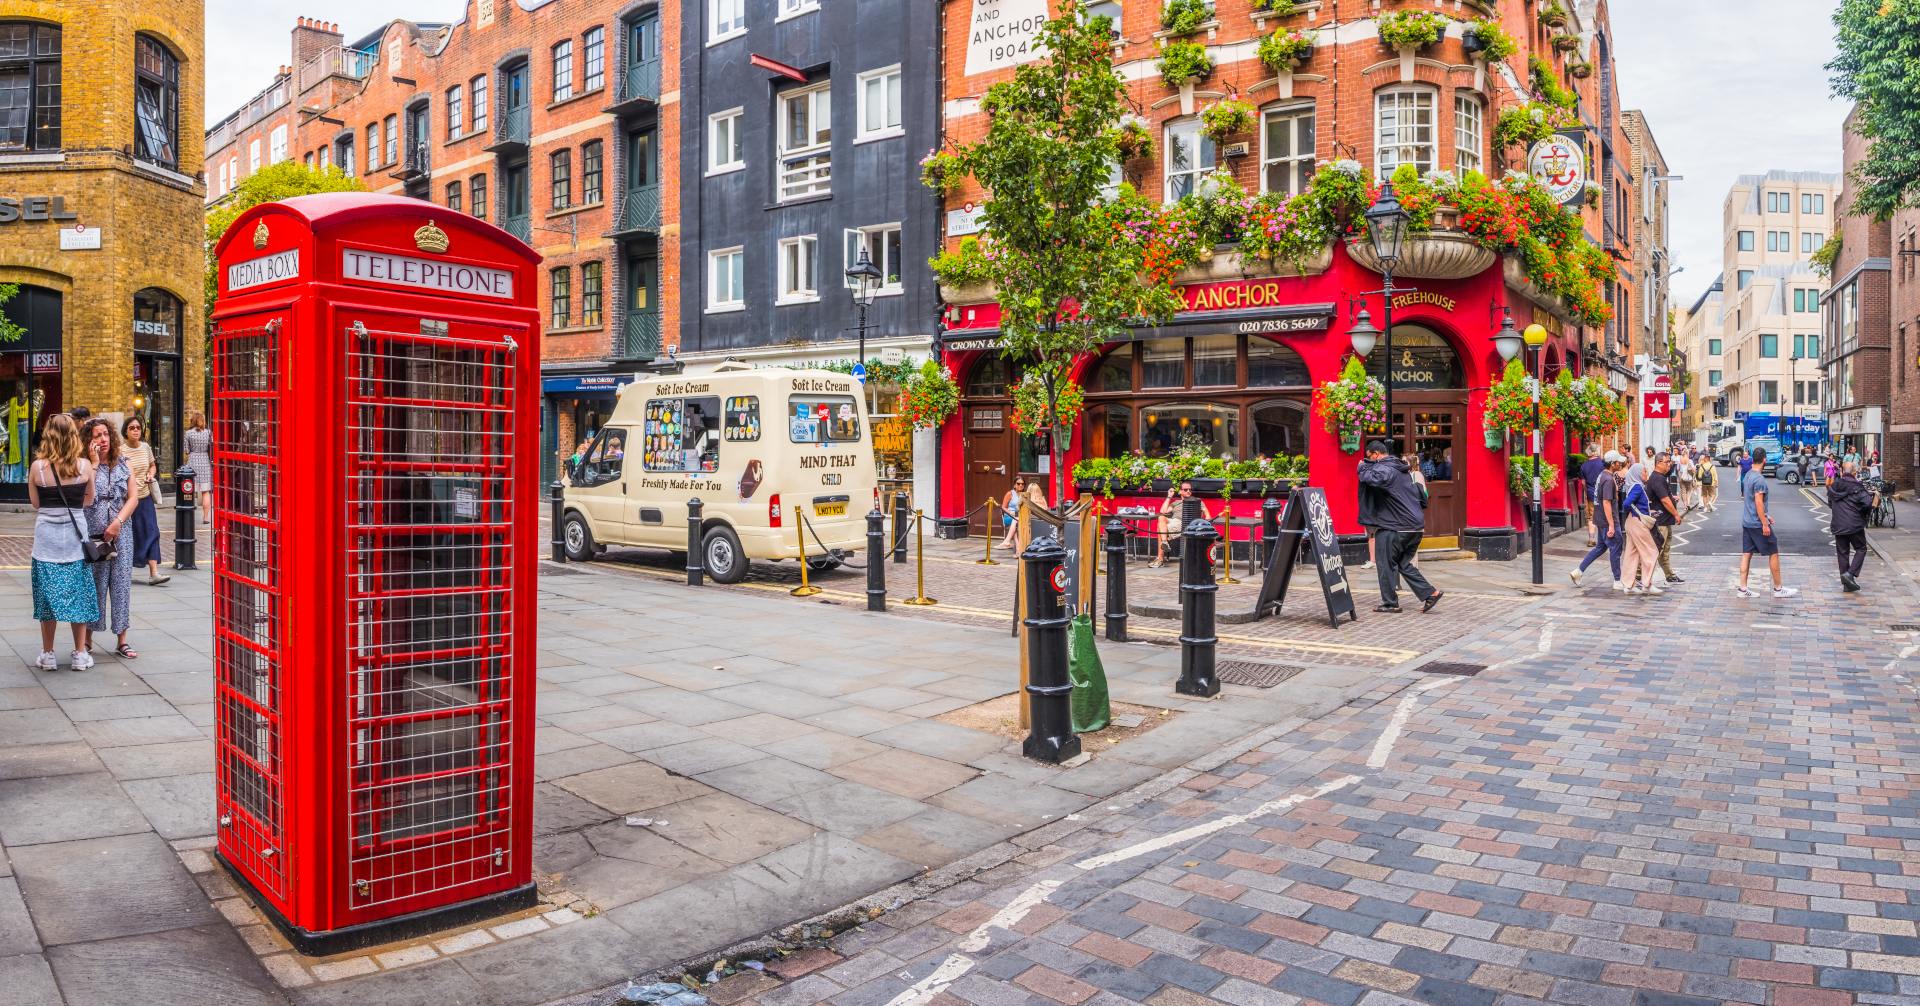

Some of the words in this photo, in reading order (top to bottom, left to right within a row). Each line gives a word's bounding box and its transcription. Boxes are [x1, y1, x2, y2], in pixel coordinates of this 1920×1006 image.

[976, 10, 1000, 24] AND
[973, 15, 1045, 45] ANCHOR
[990, 41, 1028, 62] 1904
[230, 264, 264, 289] MEDIA
[267, 250, 299, 279] BOXX
[349, 253, 506, 295] TELEPHONE
[1174, 287, 1190, 310] &
[1194, 283, 1280, 309] ANCHOR
[1392, 291, 1456, 312] FREEHOUSE
[1239, 322, 1260, 333] 020
[1262, 319, 1288, 332] 7836
[1291, 318, 1319, 329] 5649
[951, 339, 985, 350] CROWN
[987, 339, 995, 348] &
[26, 353, 58, 367] IESEL
[1402, 351, 1415, 367] &
[1383, 371, 1434, 382] NCHOR
[656, 384, 671, 396] Soft
[672, 383, 683, 394] Ice
[685, 382, 709, 393] Cream
[792, 379, 809, 391] Soft
[811, 380, 823, 391] Ice
[825, 380, 850, 391] Cream
[800, 456, 827, 468] MIND
[830, 455, 857, 467] THAT
[642, 479, 668, 490] Freshly
[669, 480, 688, 490] Made
[690, 480, 703, 490] For
[706, 480, 722, 491] You
[821, 473, 842, 485] CHILD
